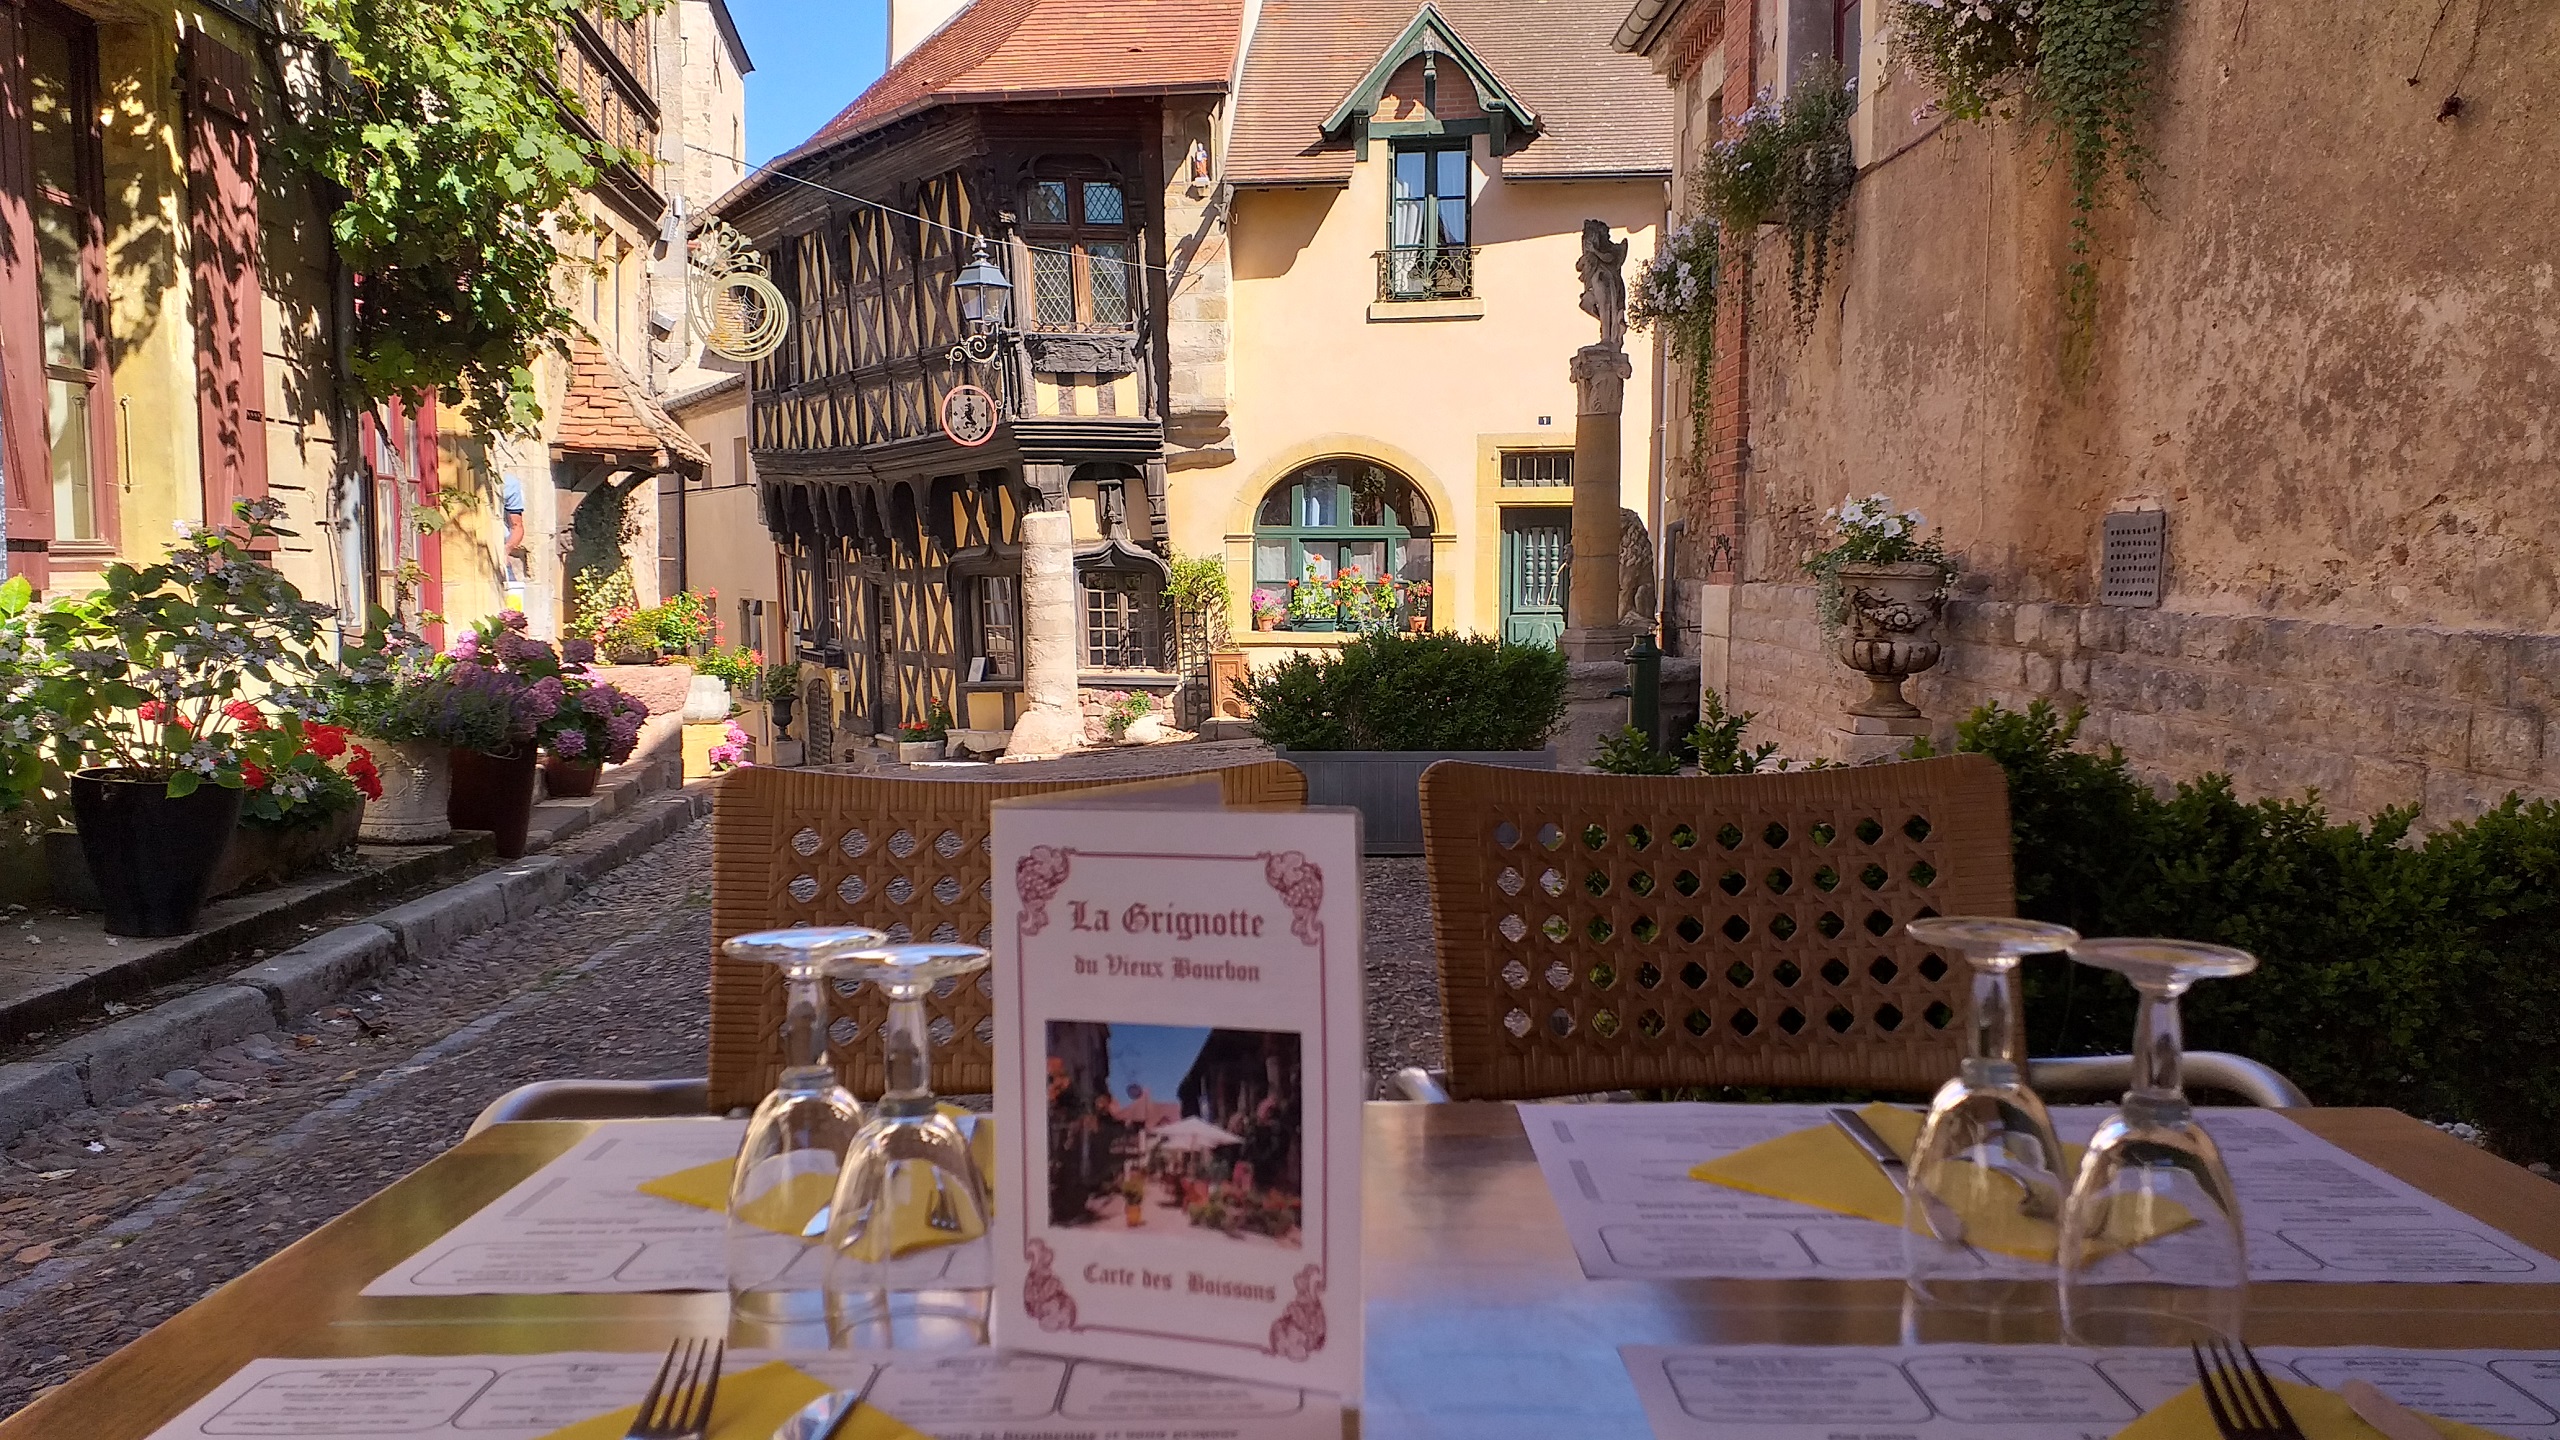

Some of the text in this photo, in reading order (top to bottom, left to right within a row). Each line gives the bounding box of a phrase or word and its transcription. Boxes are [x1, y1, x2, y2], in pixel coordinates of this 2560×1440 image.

[1068, 900, 1264, 941] La Grignotte
[1074, 953, 1261, 982] du Vieux Bourbon
[1083, 1262, 1276, 1302] Carte des Boissons
